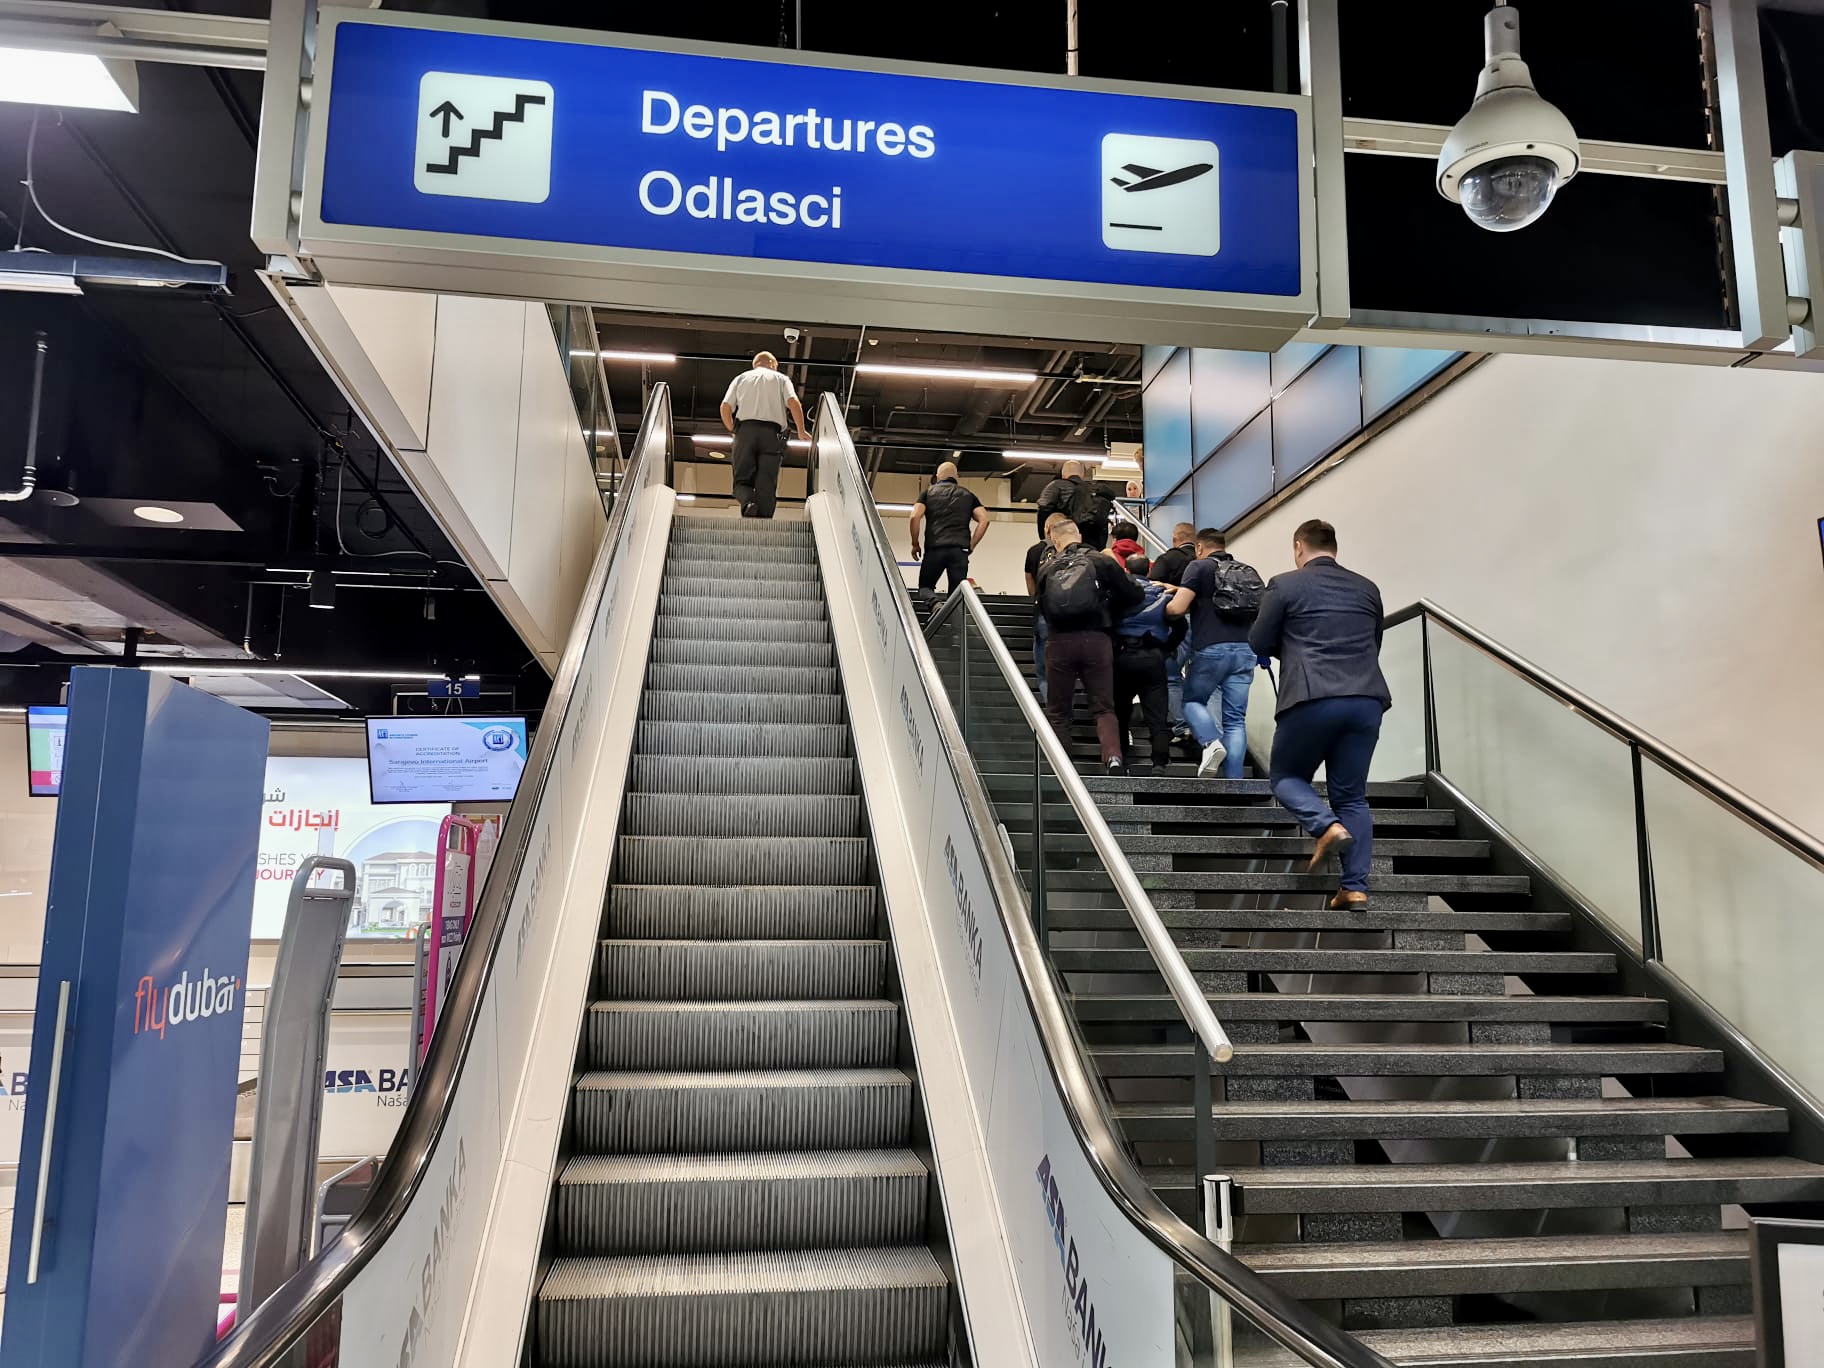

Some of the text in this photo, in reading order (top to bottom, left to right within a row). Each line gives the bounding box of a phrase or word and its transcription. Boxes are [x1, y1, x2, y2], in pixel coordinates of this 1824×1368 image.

[641, 89, 936, 158] Departures
[638, 170, 842, 229] Odlasci
[445, 683, 463, 695] 15
[268, 809, 340, 832] إنجازات
[255, 868, 325, 881] JOURY
[258, 852, 297, 866] SHES
[957, 870, 983, 980] BANKA
[134, 967, 235, 1040] flydubai
[421, 1136, 466, 1317] BANKA
